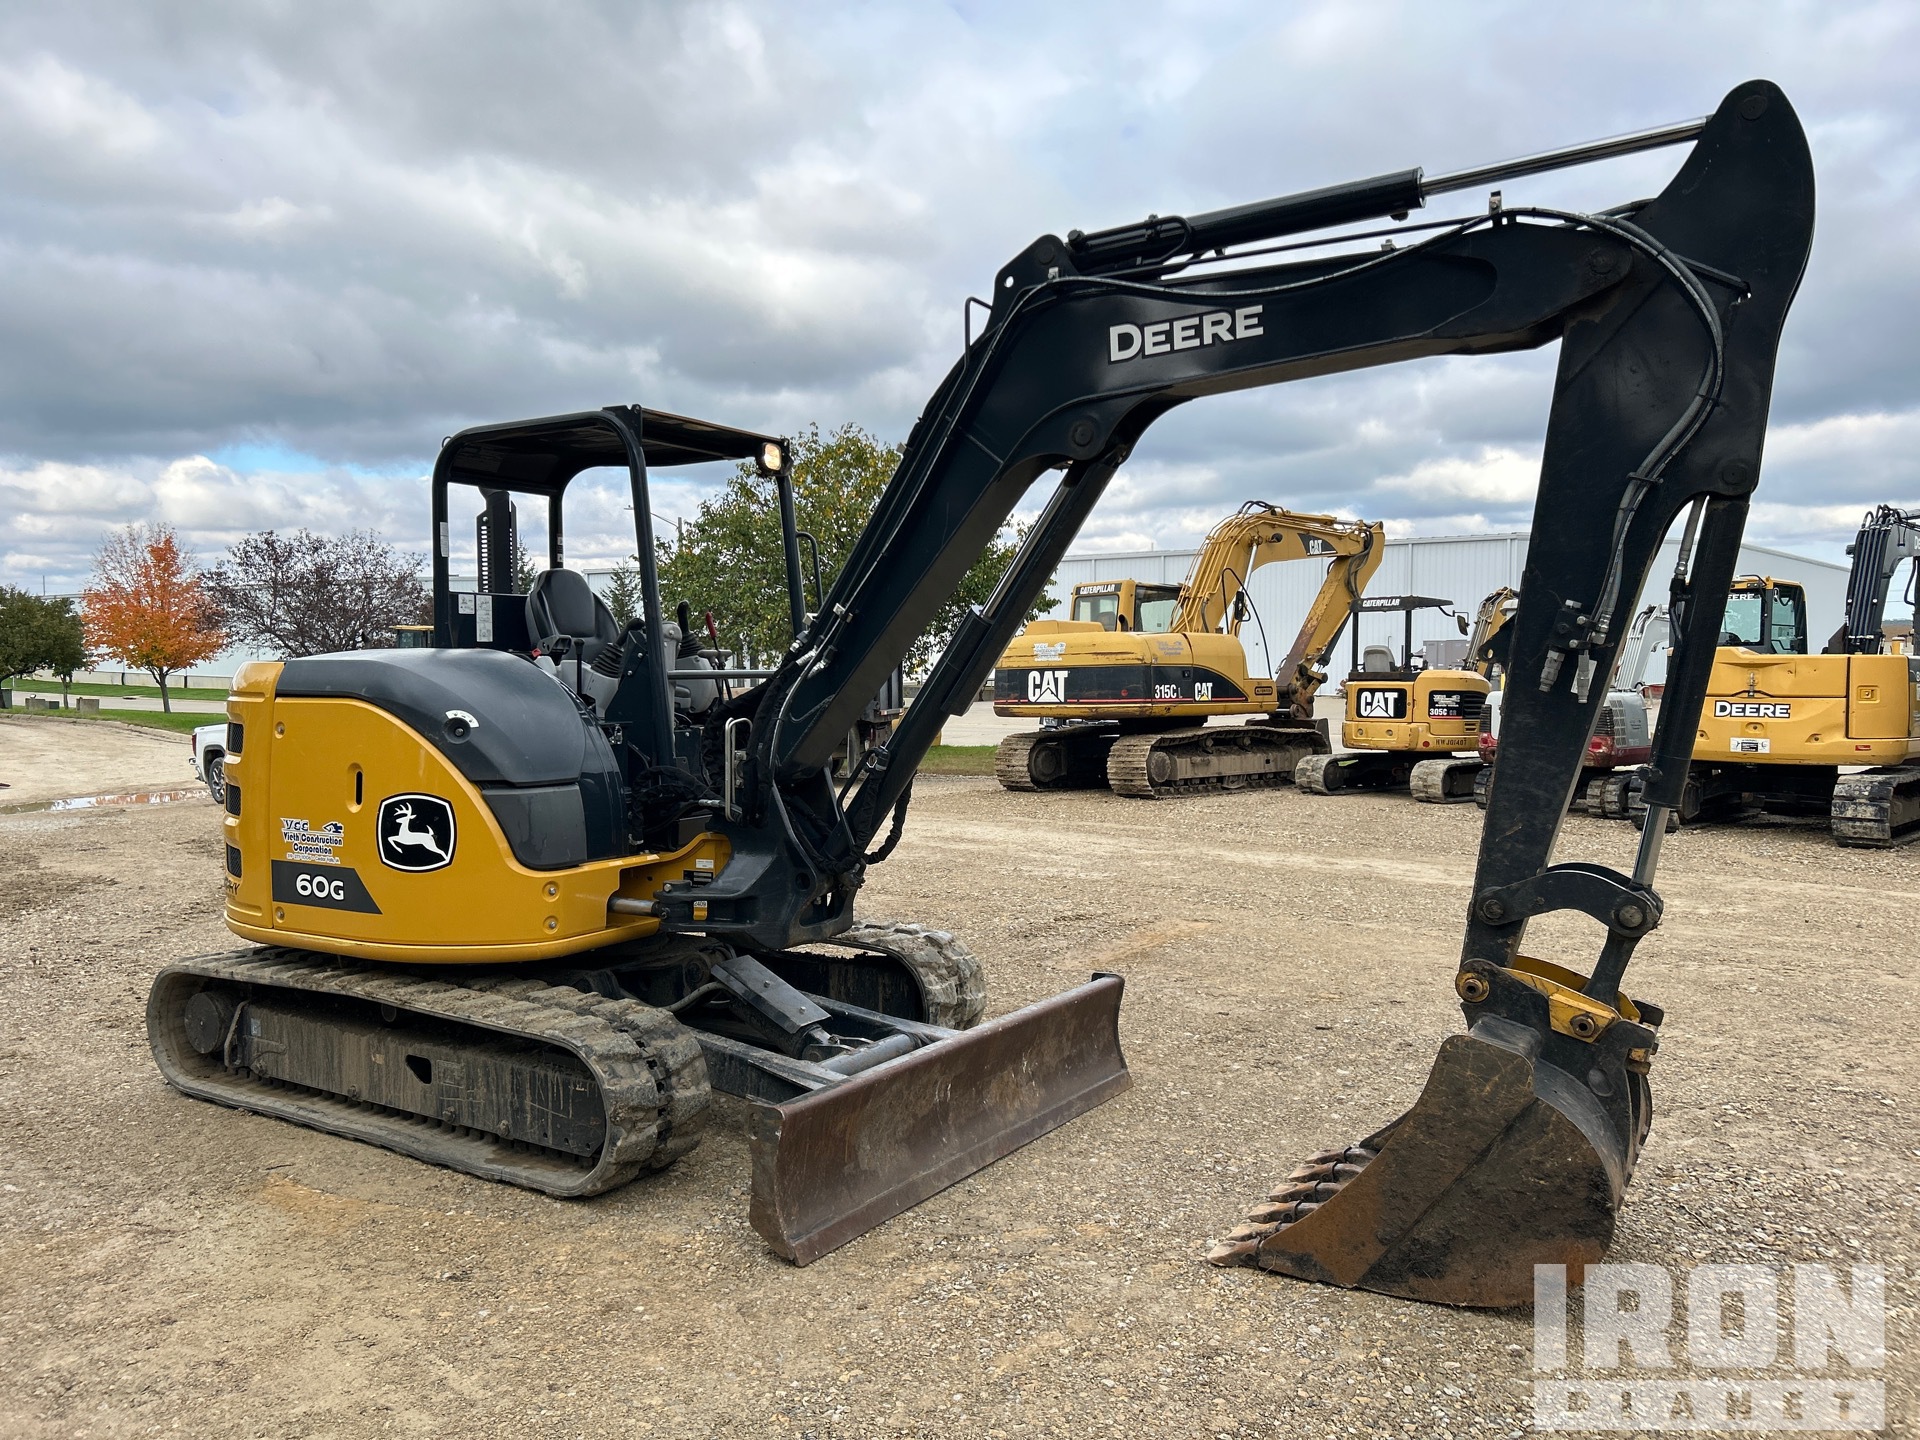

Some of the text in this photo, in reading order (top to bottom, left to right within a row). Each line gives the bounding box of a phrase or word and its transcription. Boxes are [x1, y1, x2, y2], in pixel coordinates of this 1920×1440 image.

[1109, 304, 1264, 362] DEERE
[1309, 539, 1323, 555] CAT
[1080, 584, 1116, 594] CATERPILLAR
[1362, 598, 1400, 607] CATERPILLAR
[1028, 670, 1068, 702] CAT
[1154, 684, 1177, 699] 315C
[1194, 682, 1213, 701] CAT
[1360, 691, 1398, 717] CAT
[1429, 708, 1448, 716] 305C
[1715, 701, 1790, 718] DEERE
[301, 833, 343, 846] Construction
[293, 843, 332, 854] Corporation
[296, 873, 345, 900] 60G
